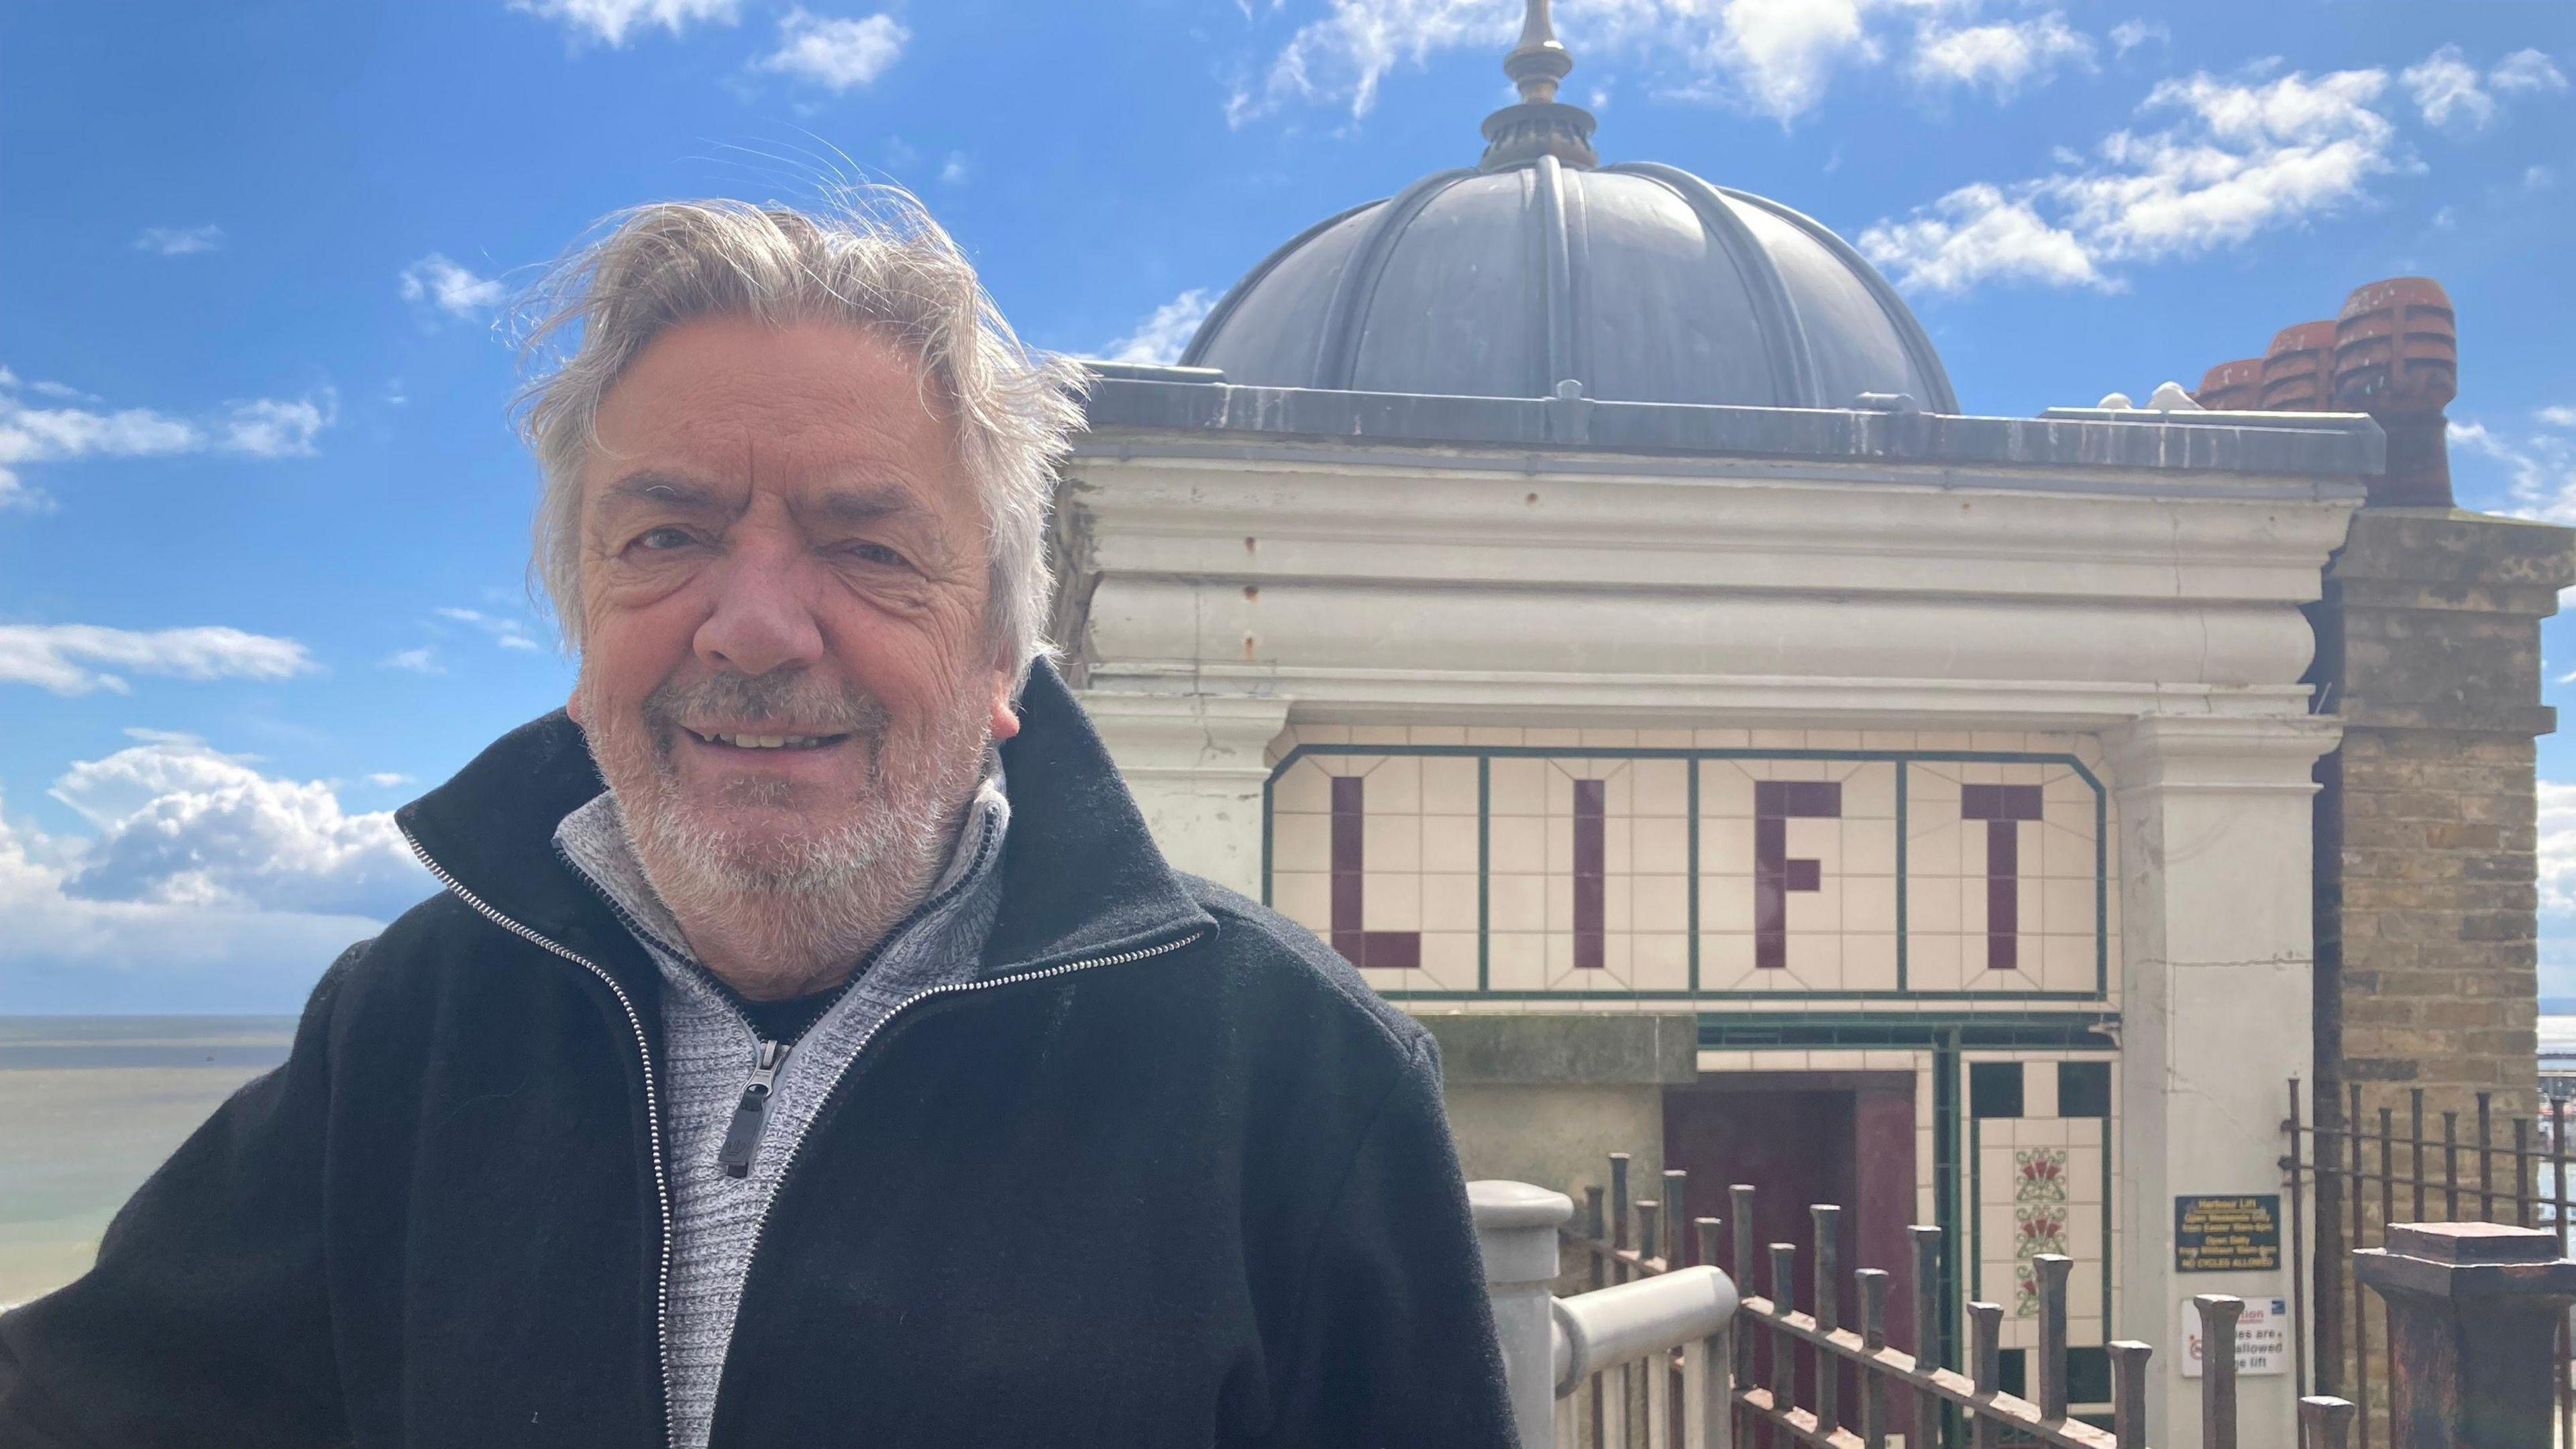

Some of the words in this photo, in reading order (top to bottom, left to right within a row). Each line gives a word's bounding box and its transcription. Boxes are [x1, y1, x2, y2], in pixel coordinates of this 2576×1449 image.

[1332, 775, 2043, 969] LIFT
[2240, 1198, 2256, 1208] Lift
[2256, 1330, 2275, 1338] are
[2236, 1342, 2283, 1353] allowed
[2250, 1357, 2267, 1367] lift
